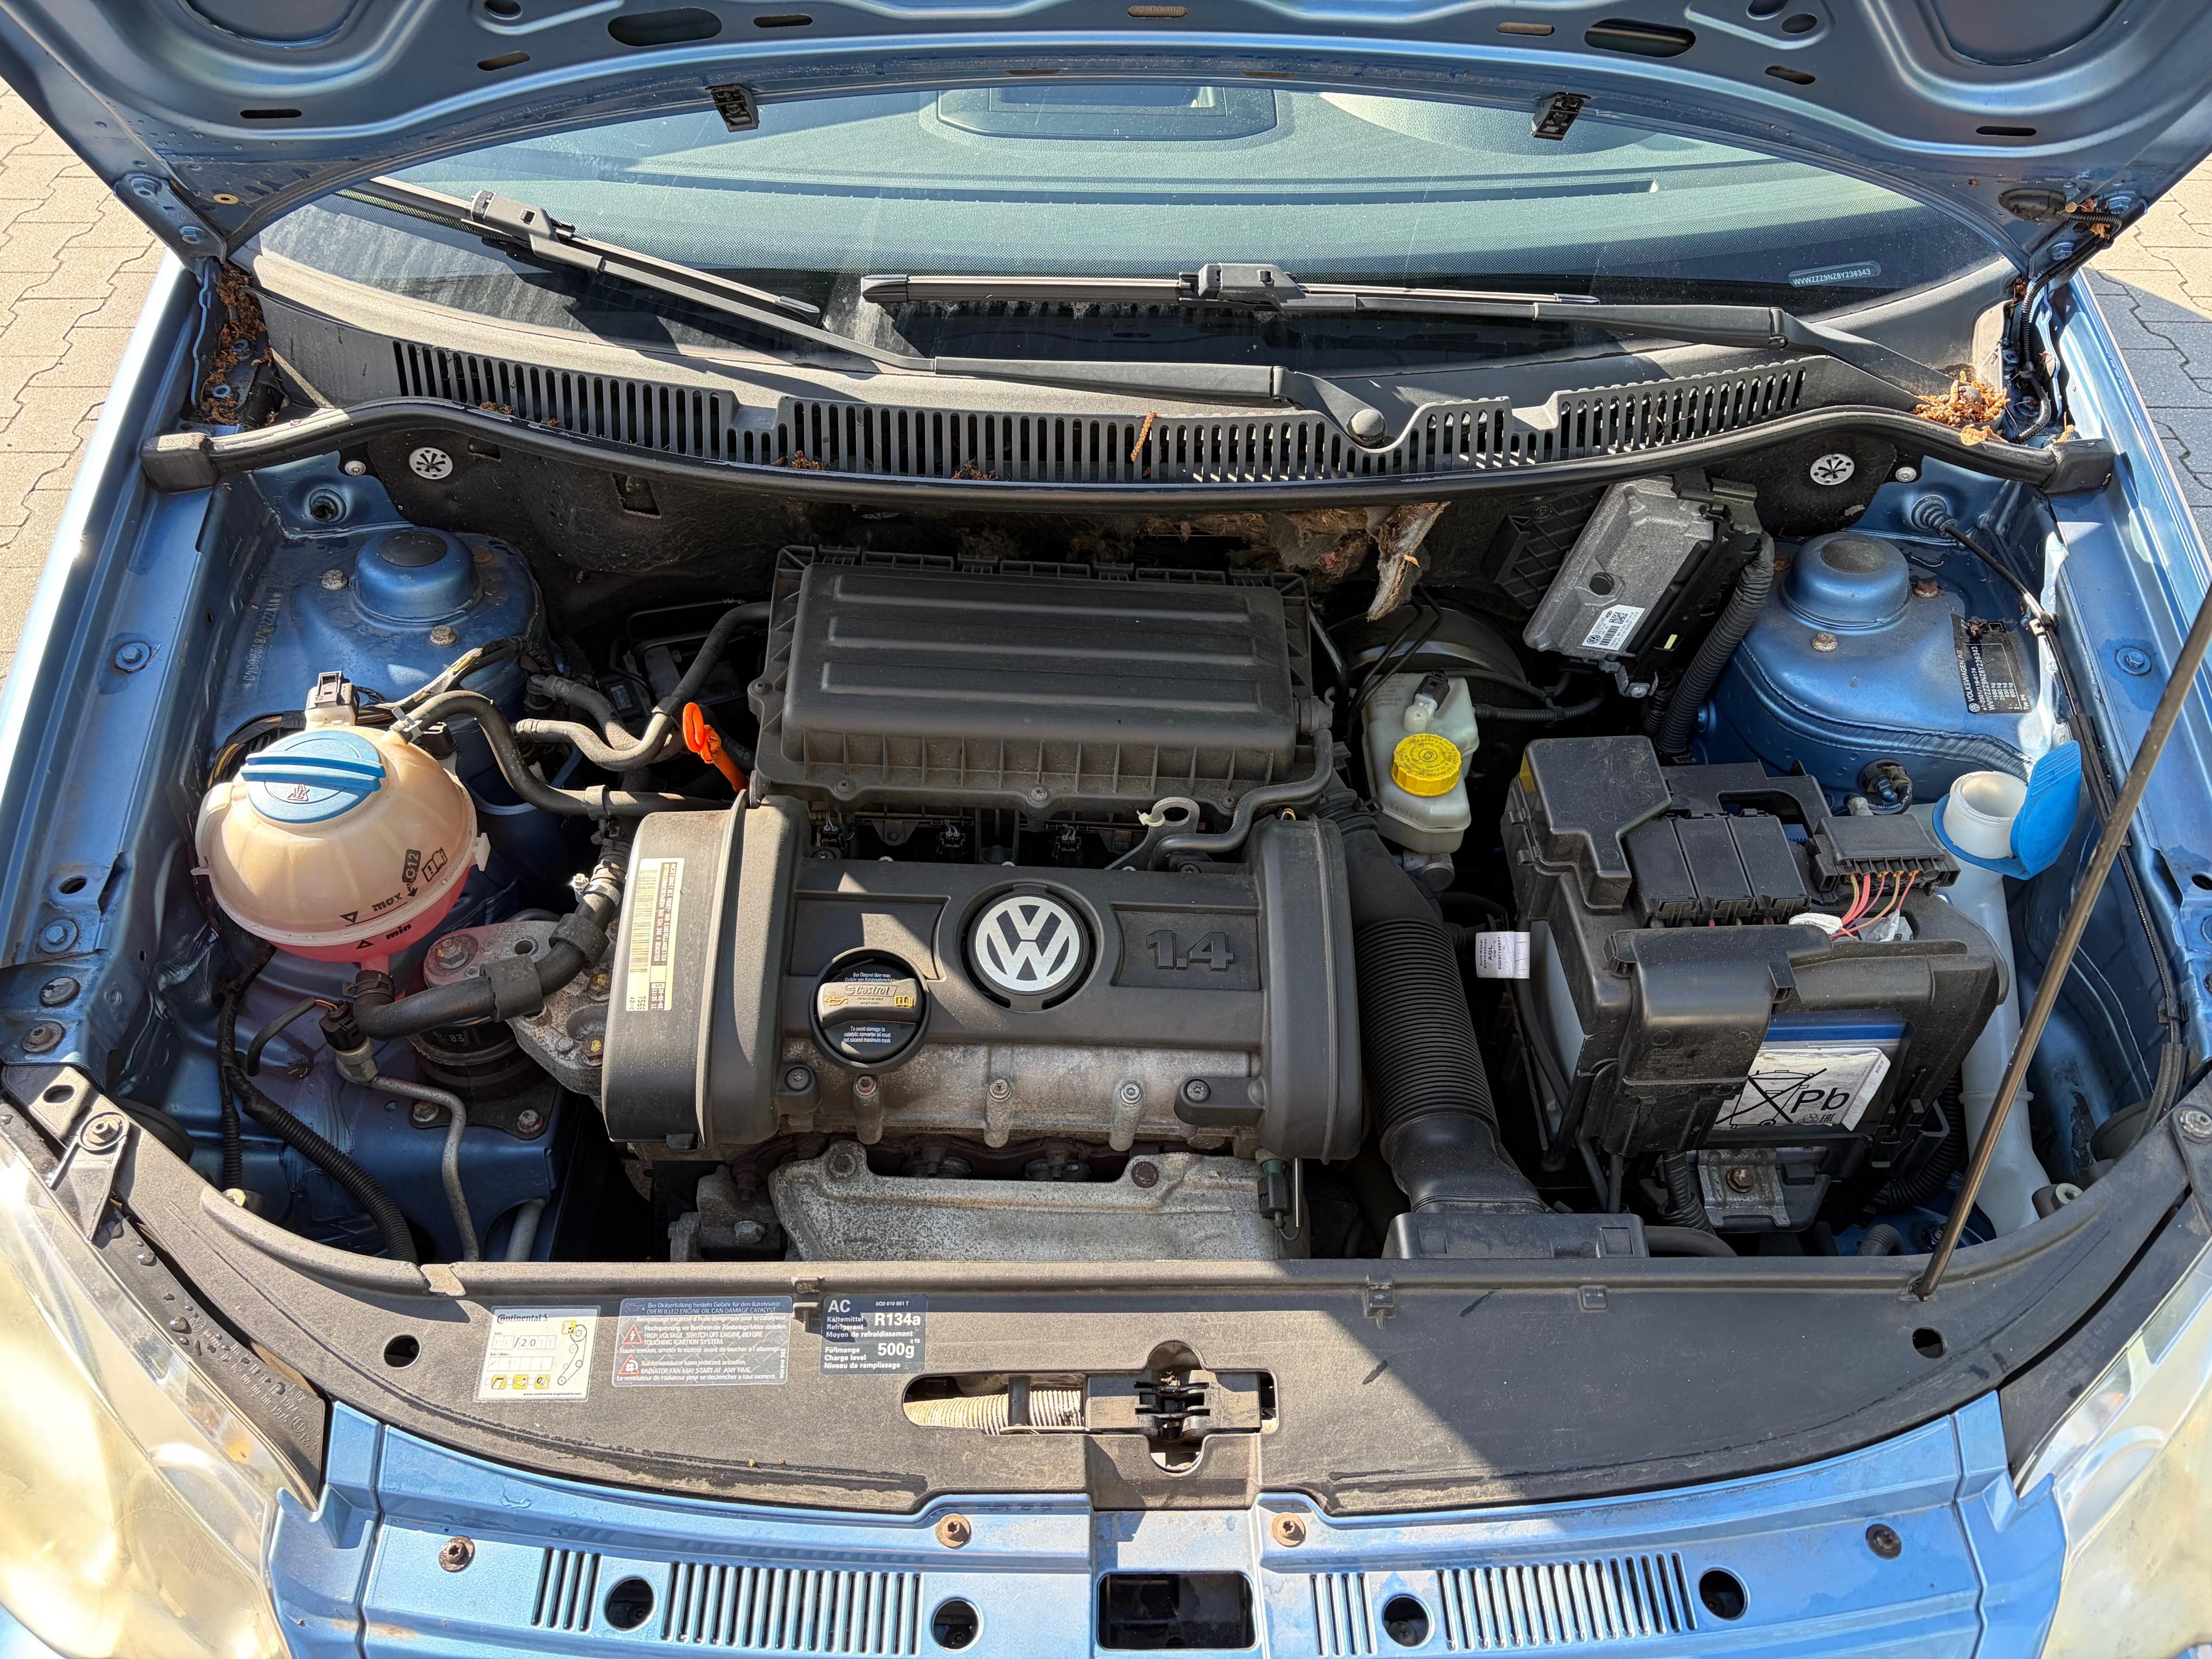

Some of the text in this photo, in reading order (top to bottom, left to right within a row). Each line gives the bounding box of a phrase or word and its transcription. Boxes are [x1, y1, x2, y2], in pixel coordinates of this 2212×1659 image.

[1792, 268, 1871, 285] WVWZZZ9NZ8Y236343
[1959, 659, 1974, 703] VOLKSWAGEN
[1971, 646, 1995, 711] WVWZZZ9NZ8Y236343
[372, 892, 403, 912] max
[386, 924, 412, 940] min
[1145, 929, 1236, 972] 1.4
[857, 986, 891, 995] Castrol
[1790, 1087, 1850, 1114] Pb
[827, 1299, 851, 1313] AC
[497, 1313, 541, 1324] Continental
[874, 1312, 921, 1326] R134a
[826, 1323, 864, 1331] Refrigerant
[825, 1346, 860, 1354] Füllmenge
[878, 1342, 915, 1359] 500g
